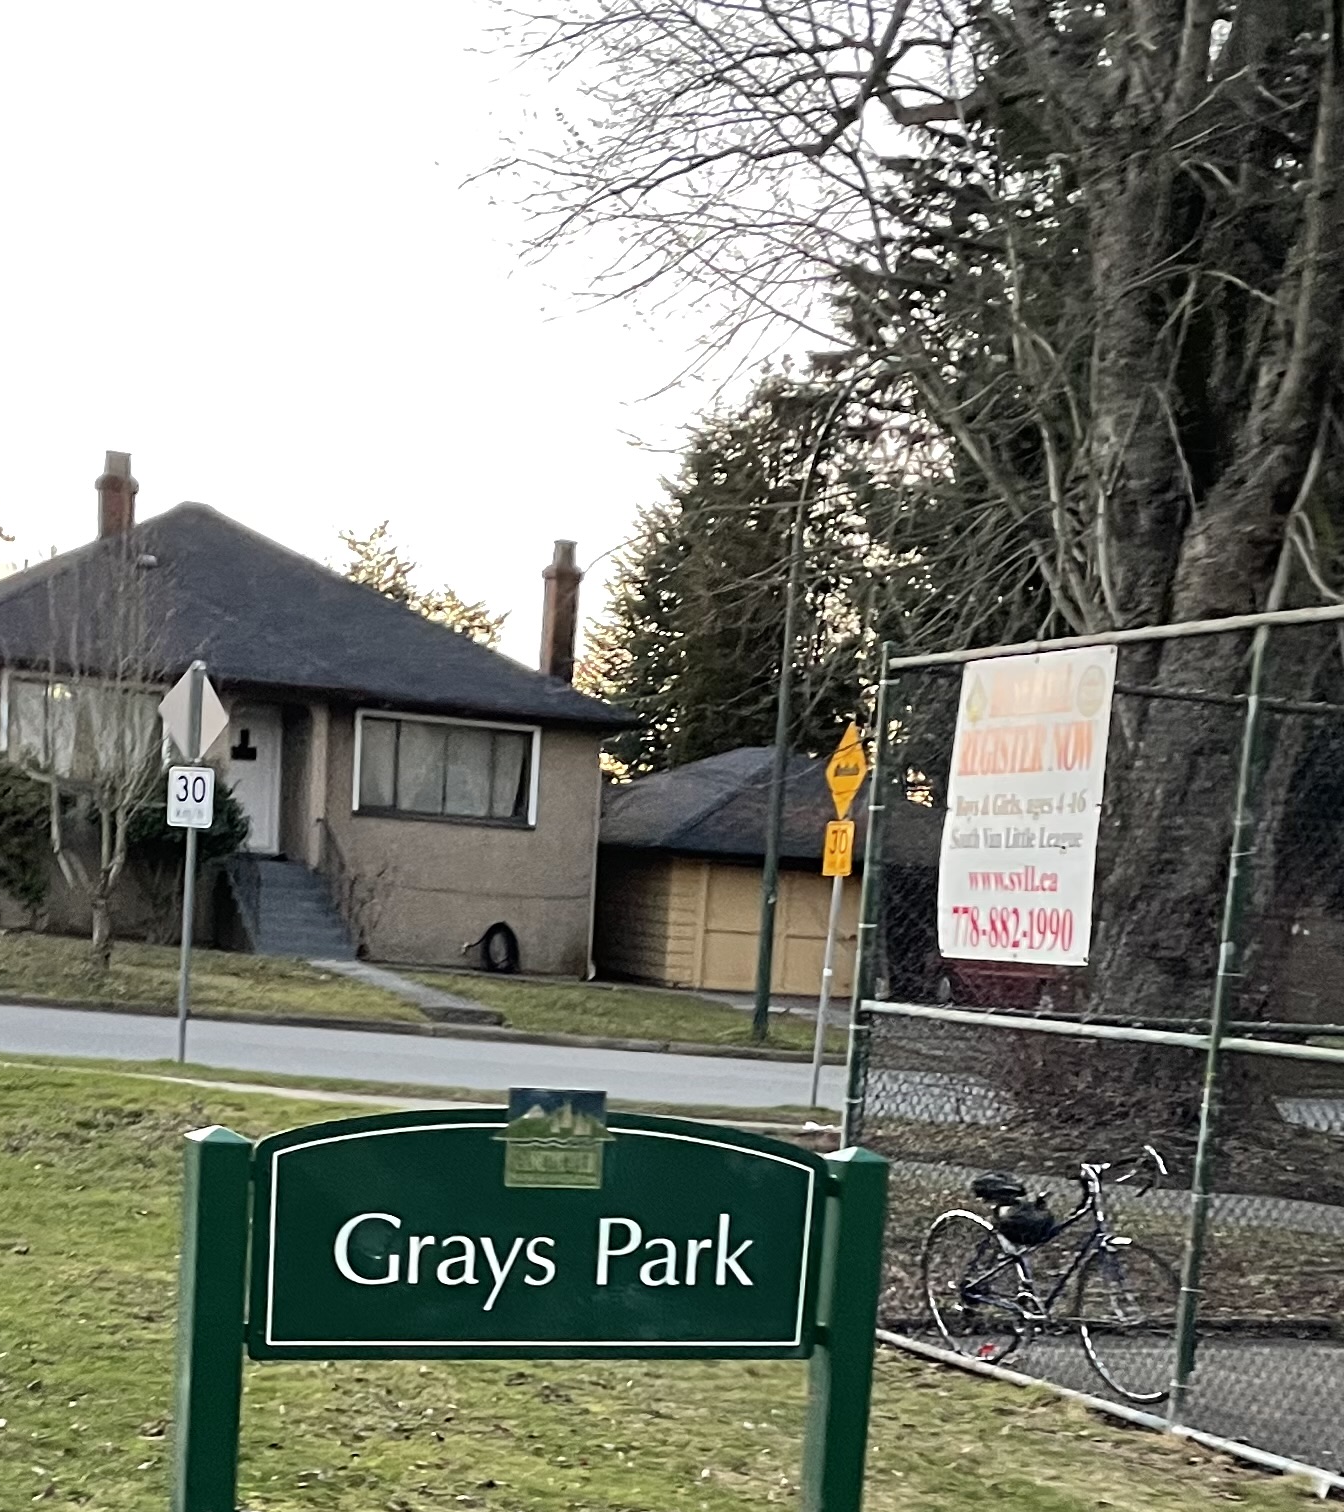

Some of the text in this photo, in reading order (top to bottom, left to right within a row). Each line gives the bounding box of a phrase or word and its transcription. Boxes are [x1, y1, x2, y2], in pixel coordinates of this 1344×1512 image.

[958, 720, 1093, 776] REGISTER NOW
[176, 775, 206, 803] 30
[968, 865, 1058, 892] www.svll.ca
[952, 906, 1073, 952] 778-882-1990
[333, 1212, 755, 1311] Grays Park
